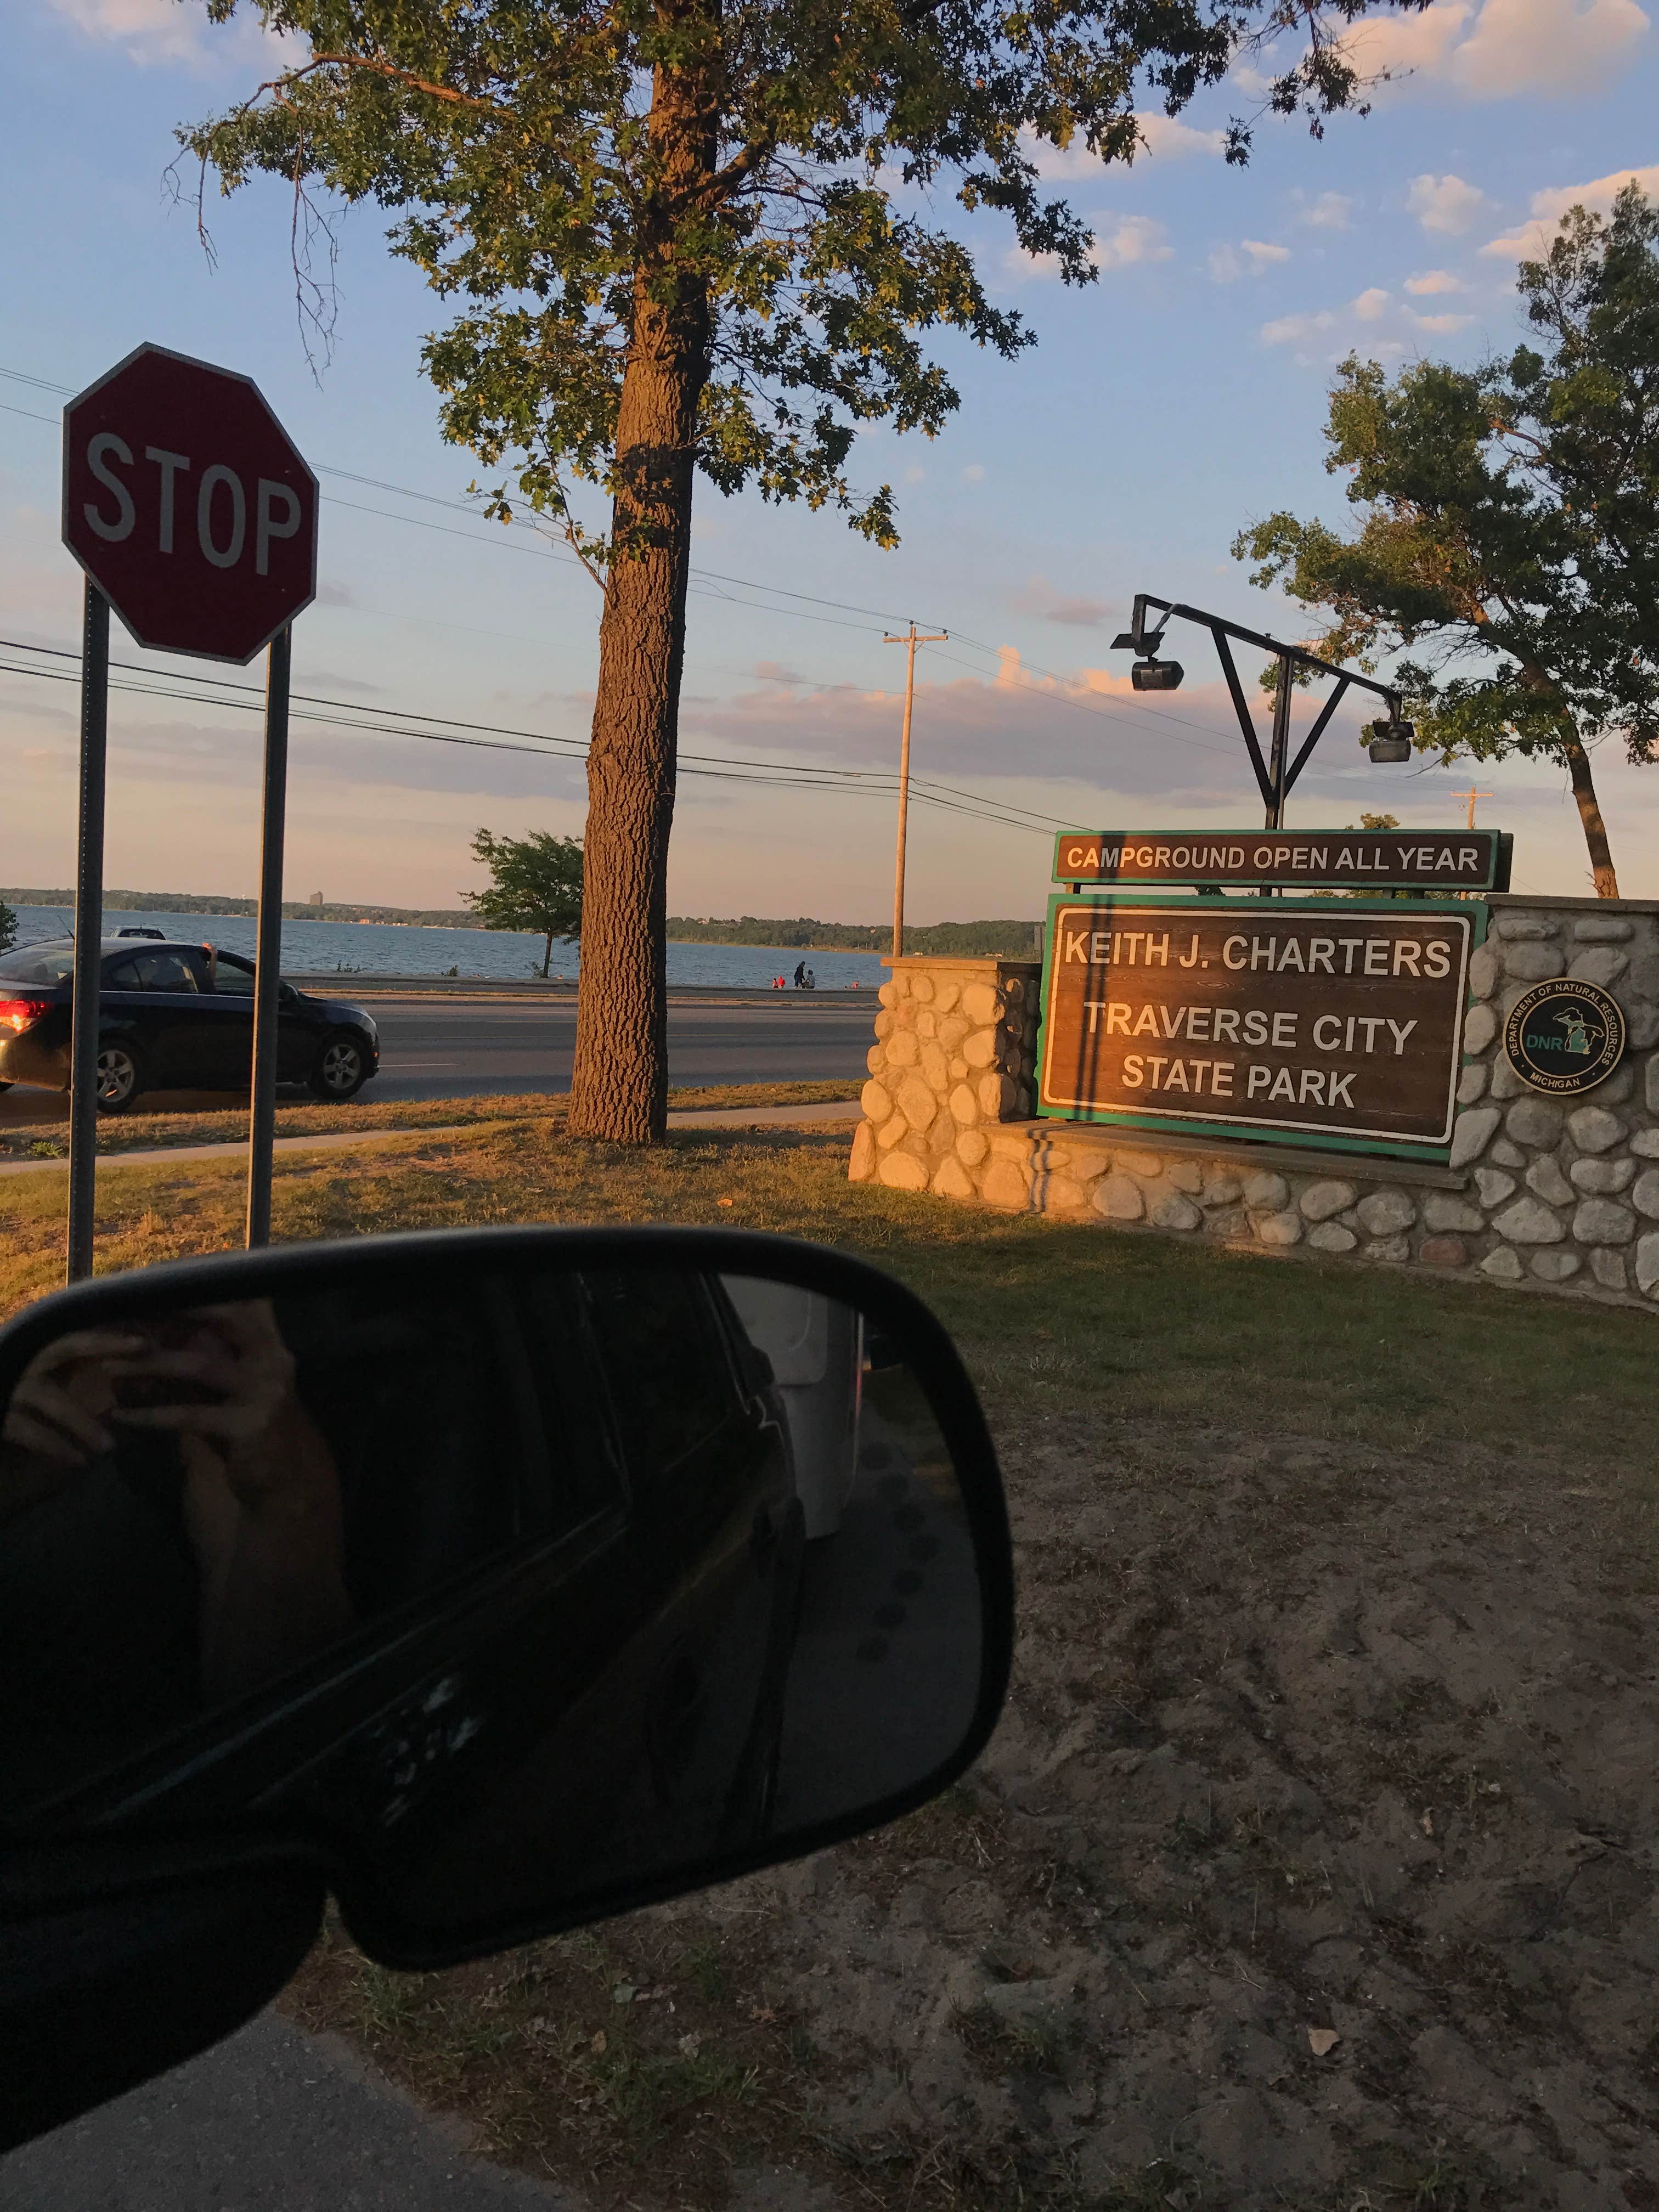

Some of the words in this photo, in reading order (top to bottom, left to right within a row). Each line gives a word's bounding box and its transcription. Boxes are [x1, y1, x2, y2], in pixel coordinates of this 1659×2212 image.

[83, 432, 301, 576] STOP
[1066, 847, 1245, 870] CAMPGROUND
[1254, 847, 1328, 870] OPEN
[1334, 847, 1390, 871] ALL
[1396, 848, 1479, 871] YEAR
[1065, 931, 1169, 967] KEITH
[1179, 934, 1209, 969] J.
[1223, 935, 1452, 979] CHARTERS
[1084, 1001, 1299, 1048] TRAVERSE
[1313, 1015, 1418, 1056] CITY
[1509, 994, 1537, 1057] DEPARTMENT
[1538, 985, 1552, 996] OF
[1555, 983, 1600, 1005] NATURAL
[1600, 1002, 1618, 1066] RESOURCES
[1526, 1035, 1564, 1051] DNR
[1121, 1054, 1235, 1097] STATE
[1247, 1065, 1358, 1109] PARK
[1530, 1072, 1580, 1088] MICHIGAN
